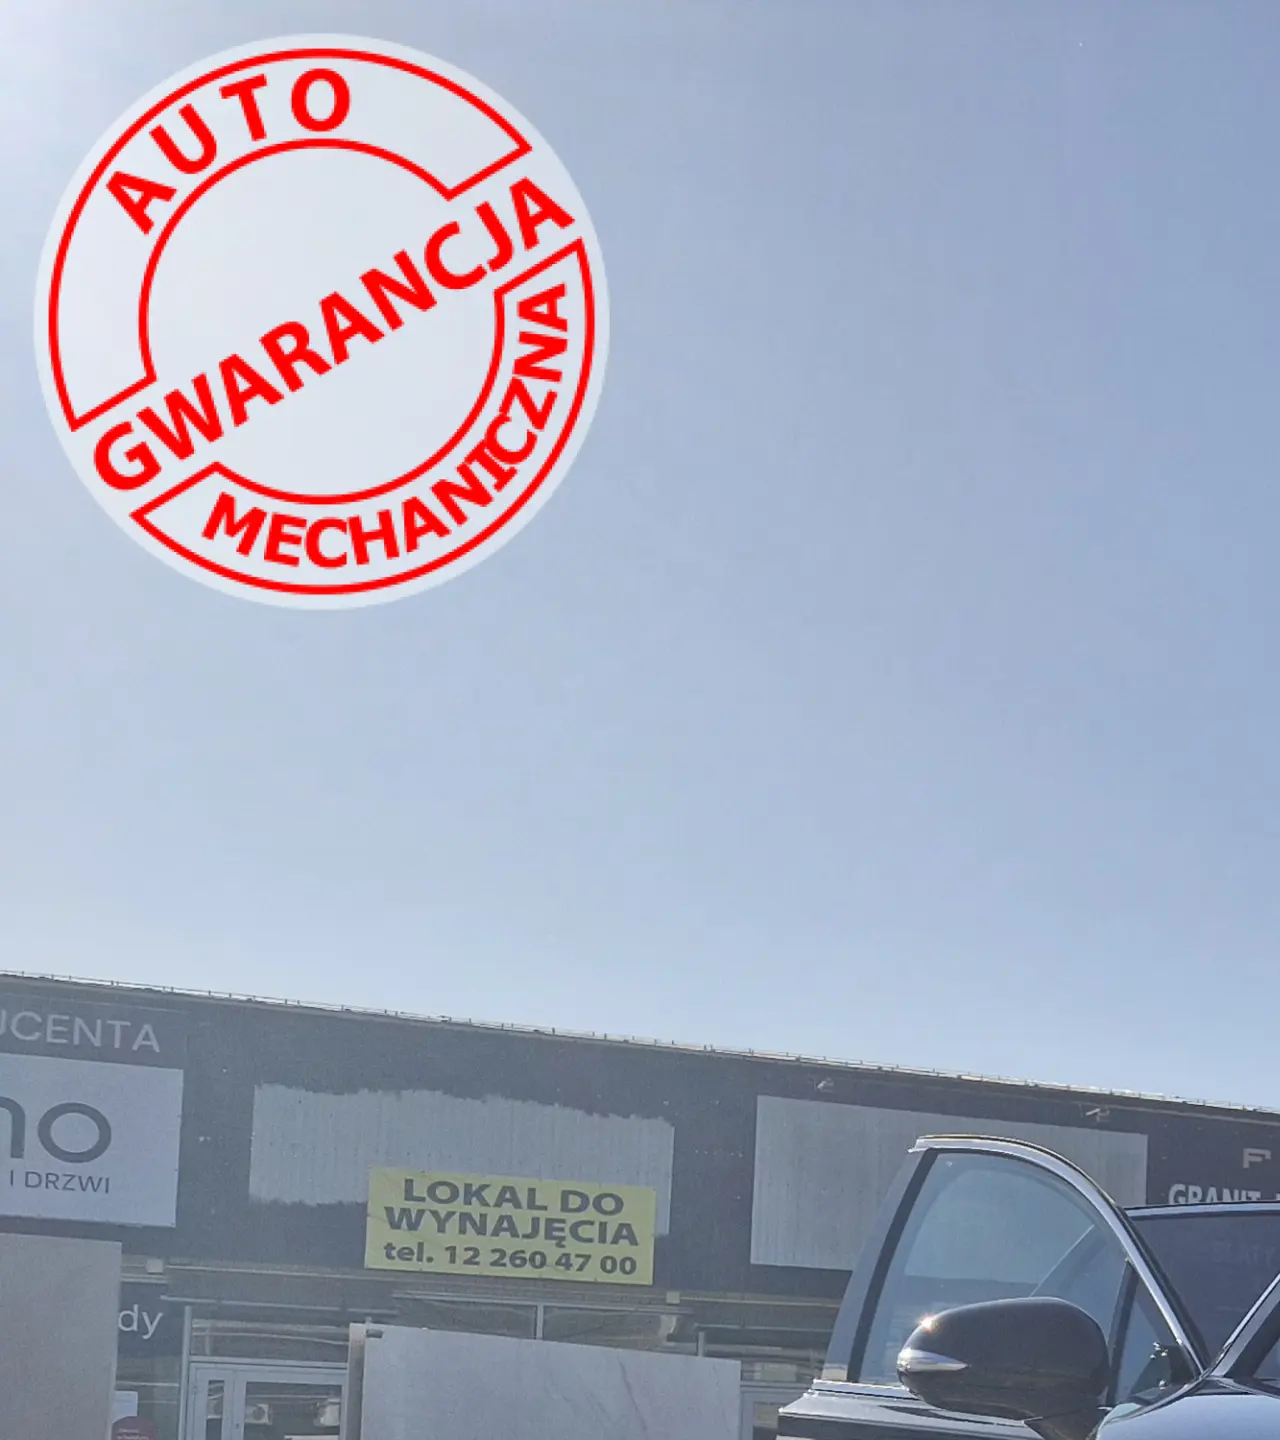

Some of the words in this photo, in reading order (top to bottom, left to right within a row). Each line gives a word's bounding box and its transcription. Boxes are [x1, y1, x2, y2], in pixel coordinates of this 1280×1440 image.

[24, 1171, 110, 1194] DRZWI
[404, 1179, 548, 1211] LOKAL
[560, 1190, 624, 1216] DO
[384, 1206, 639, 1248] WYNAJĘCIA
[384, 1242, 434, 1263] tel.
[444, 1246, 481, 1266] 12
[490, 1250, 547, 1269] 260
[555, 1253, 592, 1272] 47
[600, 1256, 637, 1275] 00
[118, 1304, 164, 1340] dy
